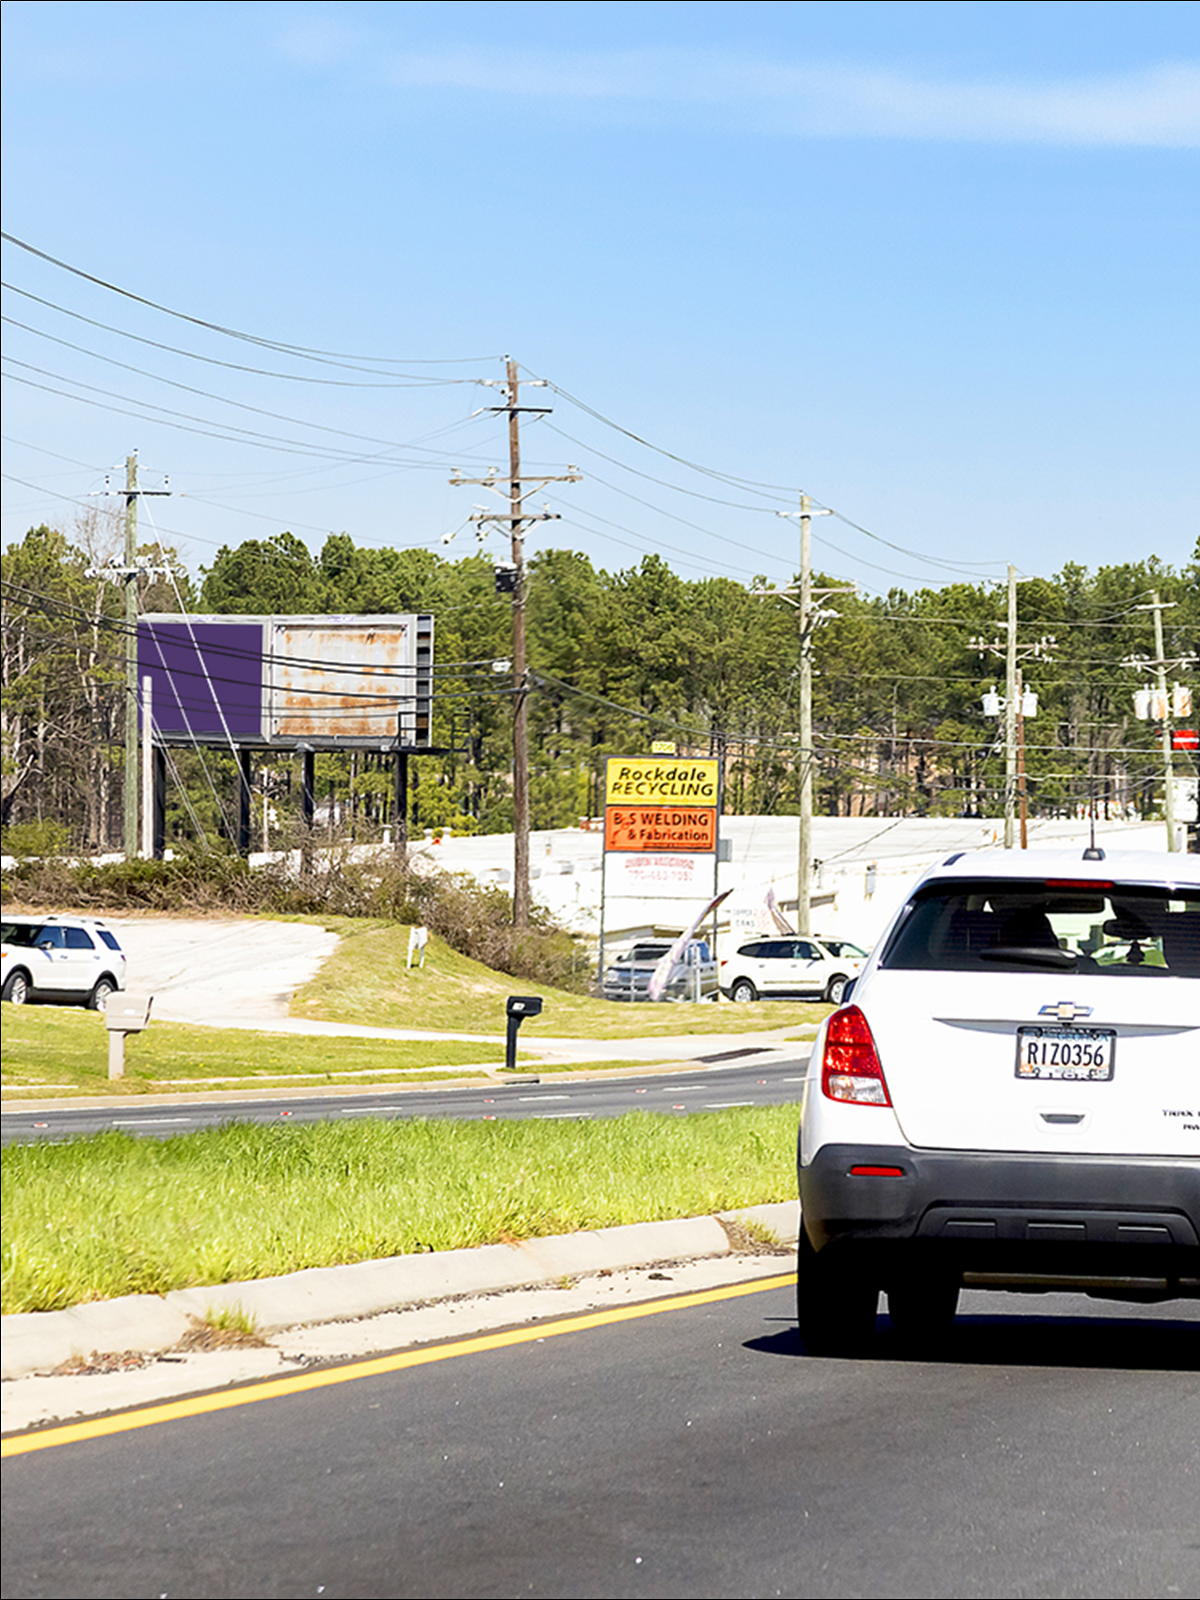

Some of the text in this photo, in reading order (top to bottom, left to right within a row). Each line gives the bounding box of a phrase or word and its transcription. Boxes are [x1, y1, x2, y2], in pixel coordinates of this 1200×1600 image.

[618, 767, 707, 782] Rockdale
[610, 782, 715, 796] RECYCLING
[641, 813, 709, 826] WELDING
[627, 829, 709, 841] & Fabrication
